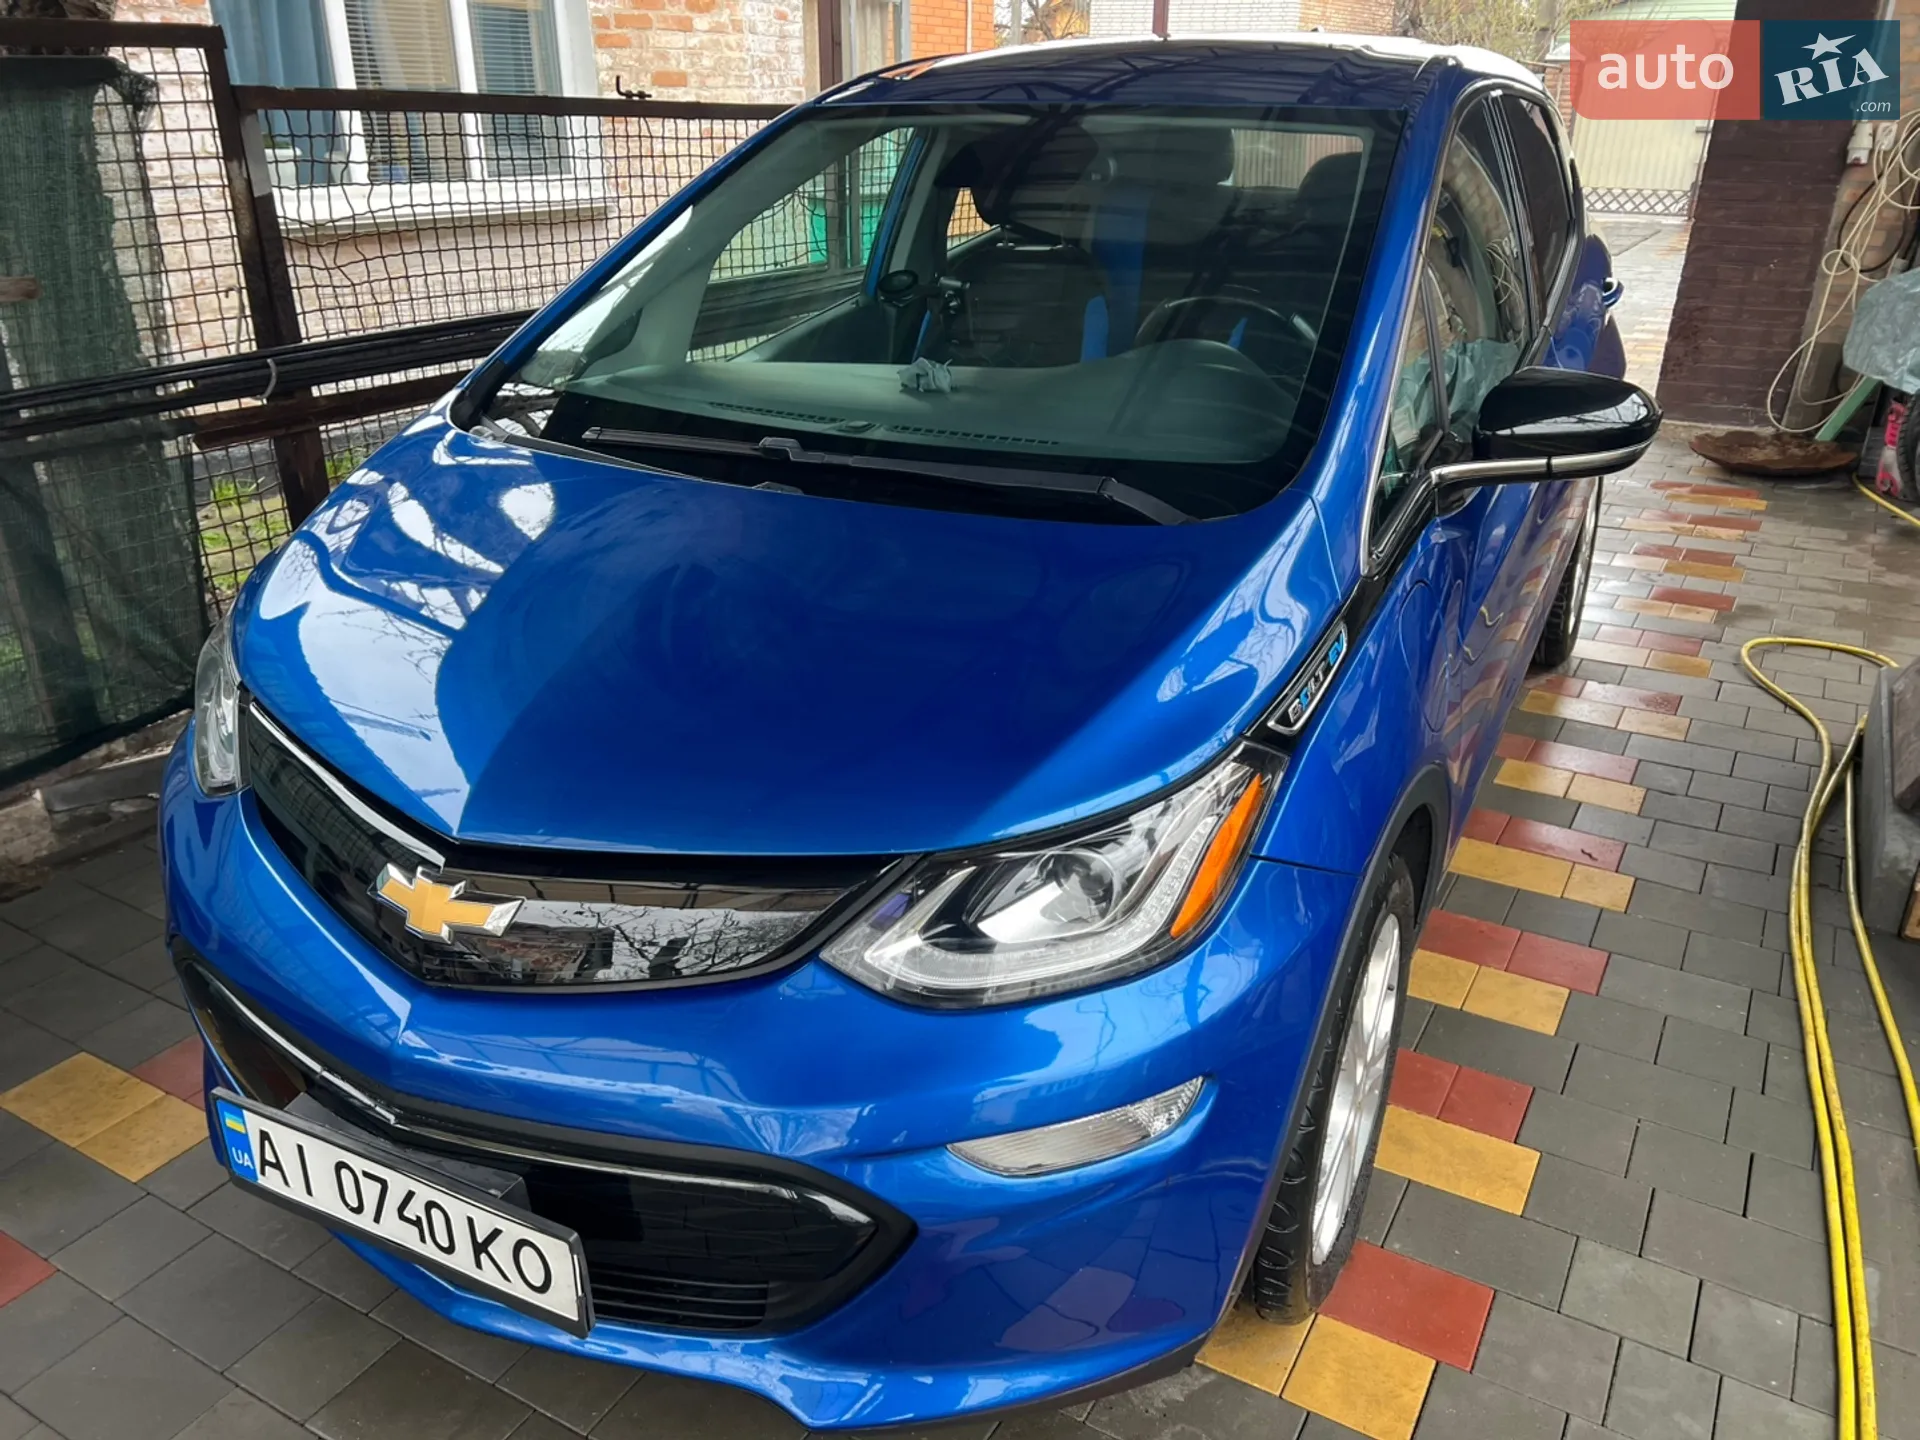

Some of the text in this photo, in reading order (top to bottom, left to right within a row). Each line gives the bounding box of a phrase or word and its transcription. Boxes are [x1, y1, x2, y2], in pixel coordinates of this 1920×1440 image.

[232, 1146, 255, 1170] UA
[258, 1128, 553, 1295] AI 0740 KO
